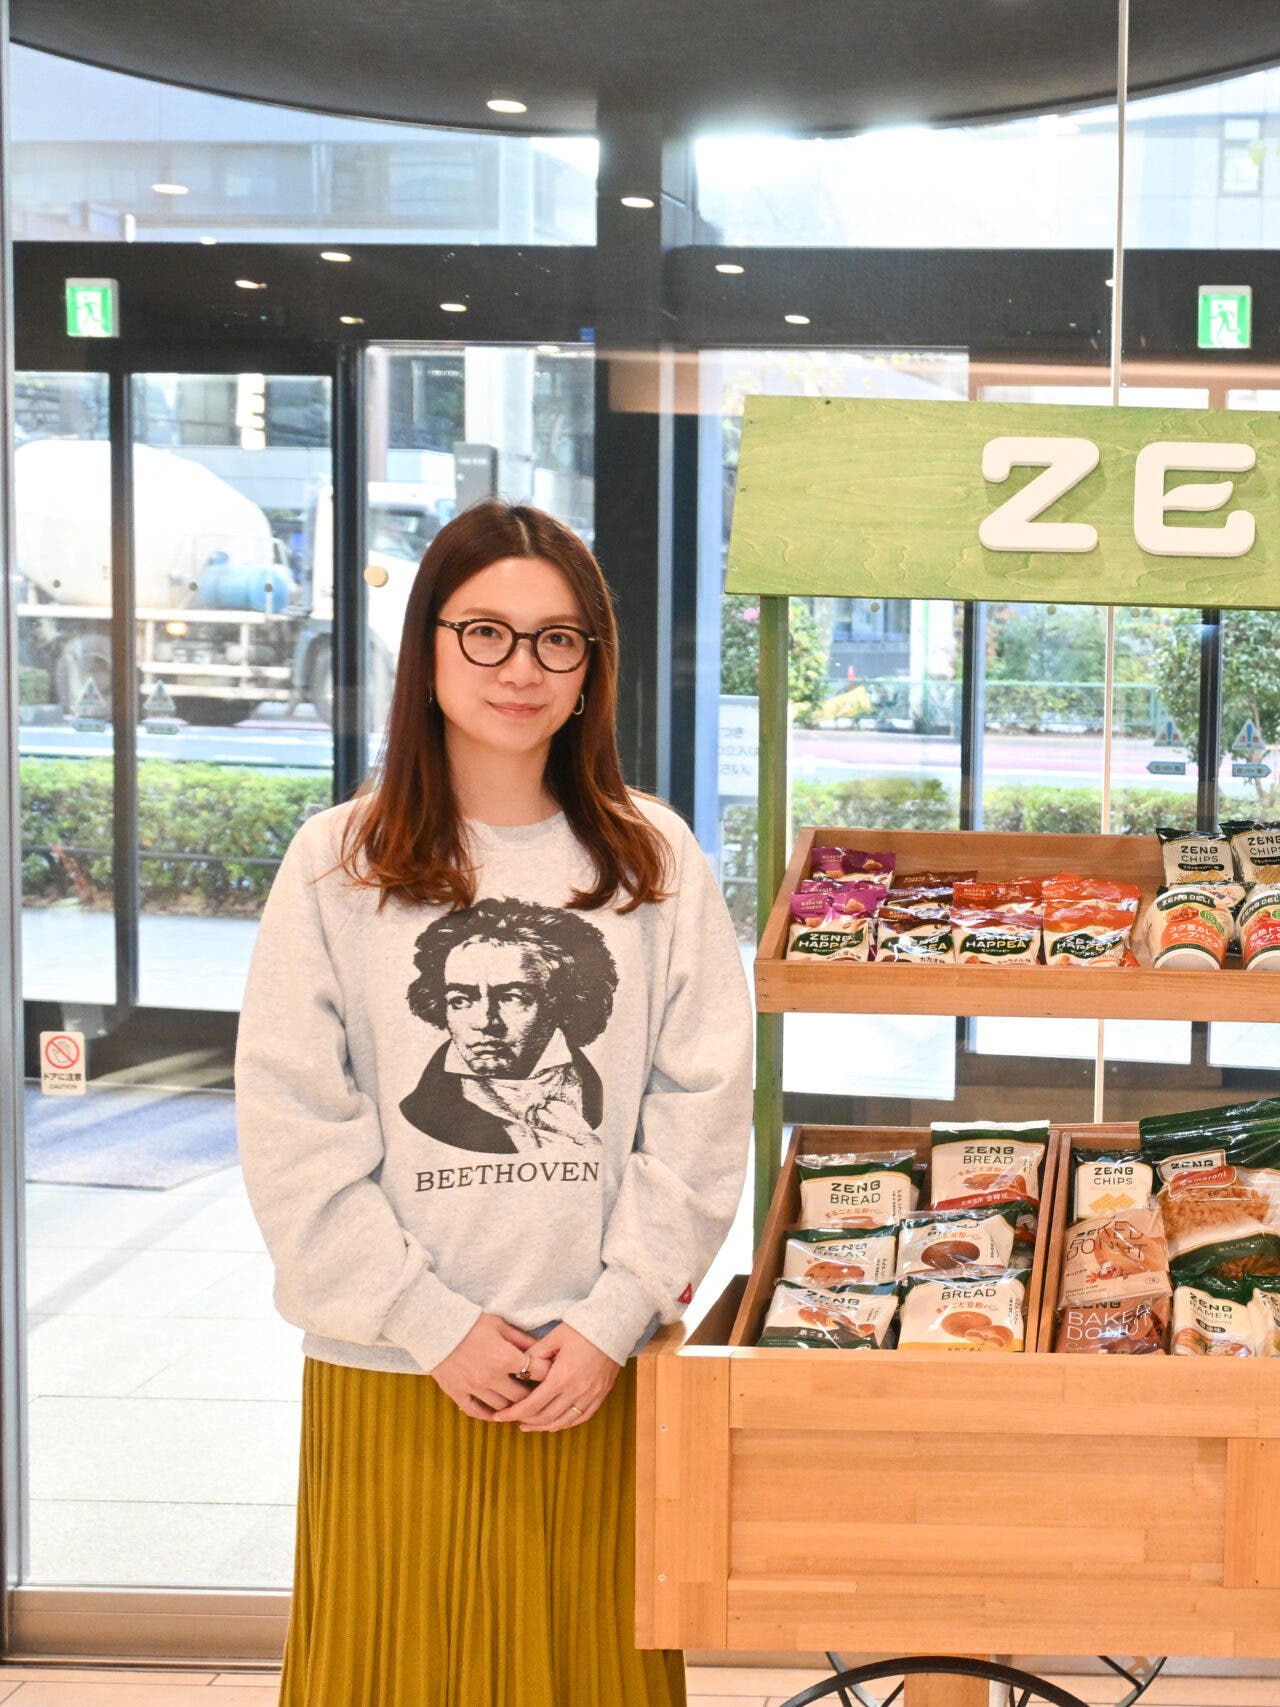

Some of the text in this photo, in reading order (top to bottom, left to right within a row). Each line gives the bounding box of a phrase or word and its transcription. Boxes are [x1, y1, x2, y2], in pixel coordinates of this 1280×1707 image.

[1181, 845, 1218, 854] ZENB
[1181, 855, 1219, 863] CHIPS
[966, 940, 1027, 949] HAPPEA
[964, 1146, 1014, 1155] ZENB
[963, 1155, 1014, 1165] BREAD
[1094, 1166, 1134, 1176] ZENB
[415, 1162, 600, 1192] BEETHOVEN
[1093, 1177, 1133, 1186] CHIPS
[831, 1180, 880, 1194] ZENB
[830, 1193, 881, 1206] BREAD
[941, 1287, 997, 1300] BREAD
[1190, 1292, 1233, 1312] ZENB
